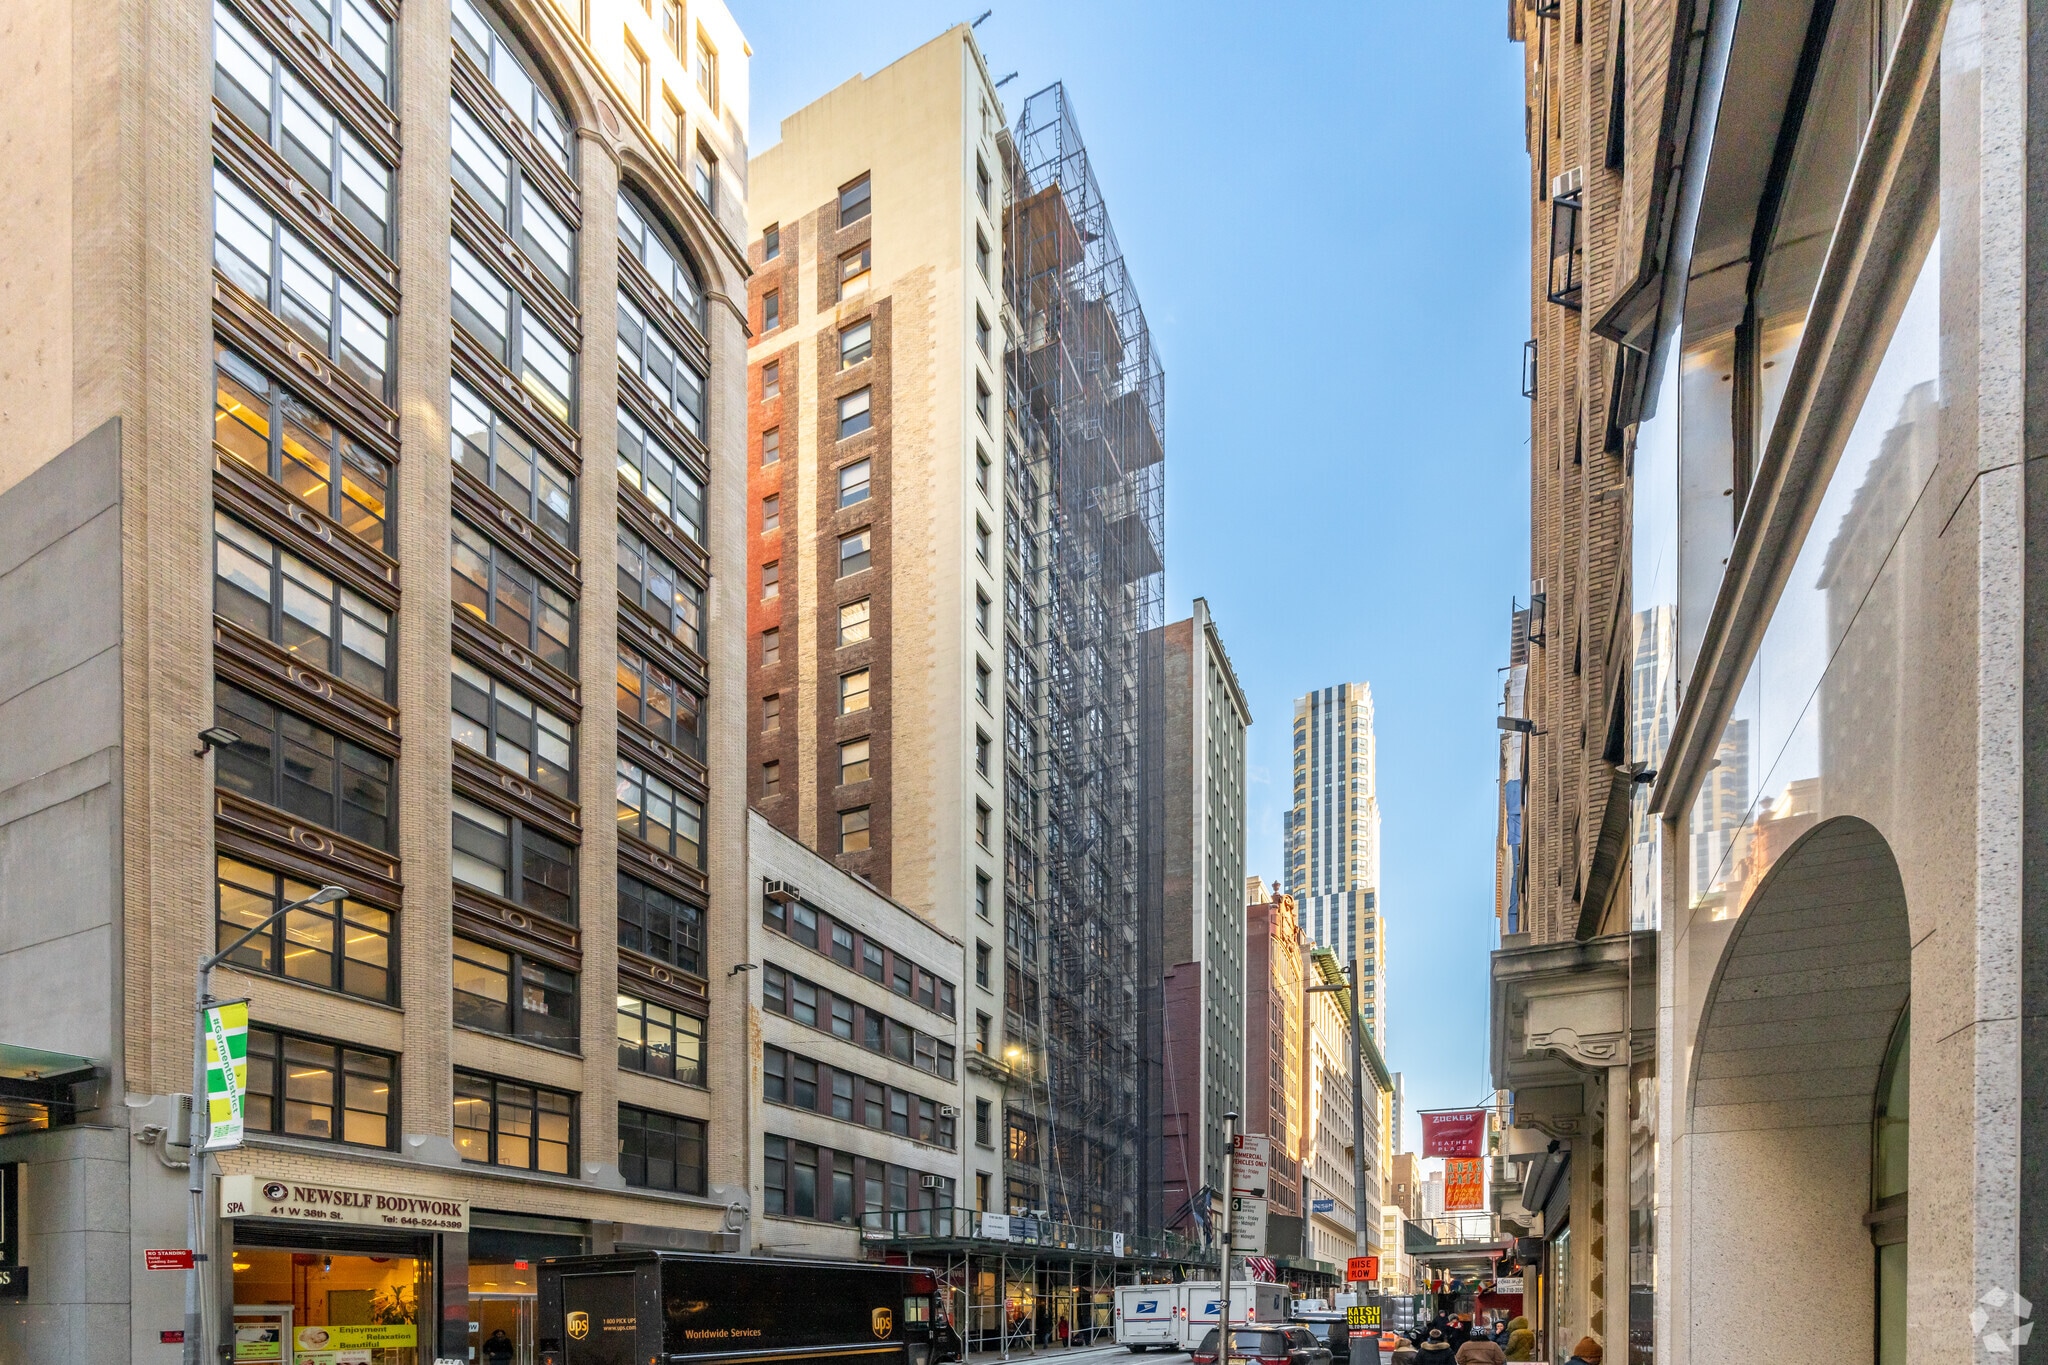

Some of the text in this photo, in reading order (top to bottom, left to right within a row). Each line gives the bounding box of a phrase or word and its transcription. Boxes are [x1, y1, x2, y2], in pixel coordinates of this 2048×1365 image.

[213, 1018, 238, 1113] #GarmentDistrict
[1433, 1114, 1473, 1123] ZUCKER
[1234, 1136, 1240, 1147] 3
[1432, 1139, 1473, 1147] FEATHER
[1234, 1152, 1262, 1160] OMMERCIAL
[1448, 1161, 1482, 1173] ANAS
[1448, 1173, 1480, 1185] CAFE
[293, 1186, 462, 1217] NEWSELF BODYWORK
[1232, 1199, 1239, 1210] 6
[227, 1202, 245, 1213] SPA
[271, 1206, 343, 1219] 41 W 38th St.
[382, 1214, 462, 1229] Tel: 646-524-5399
[1351, 1260, 1371, 1268] RAISE
[1351, 1270, 1370, 1278] PLOW
[1348, 1306, 1380, 1316] KATSU
[874, 1317, 891, 1334] ups
[1348, 1315, 1380, 1325] SUSHI
[339, 1326, 387, 1334] Enjoyment
[569, 1320, 588, 1335] ups
[685, 1327, 762, 1339] Worldwide Services
